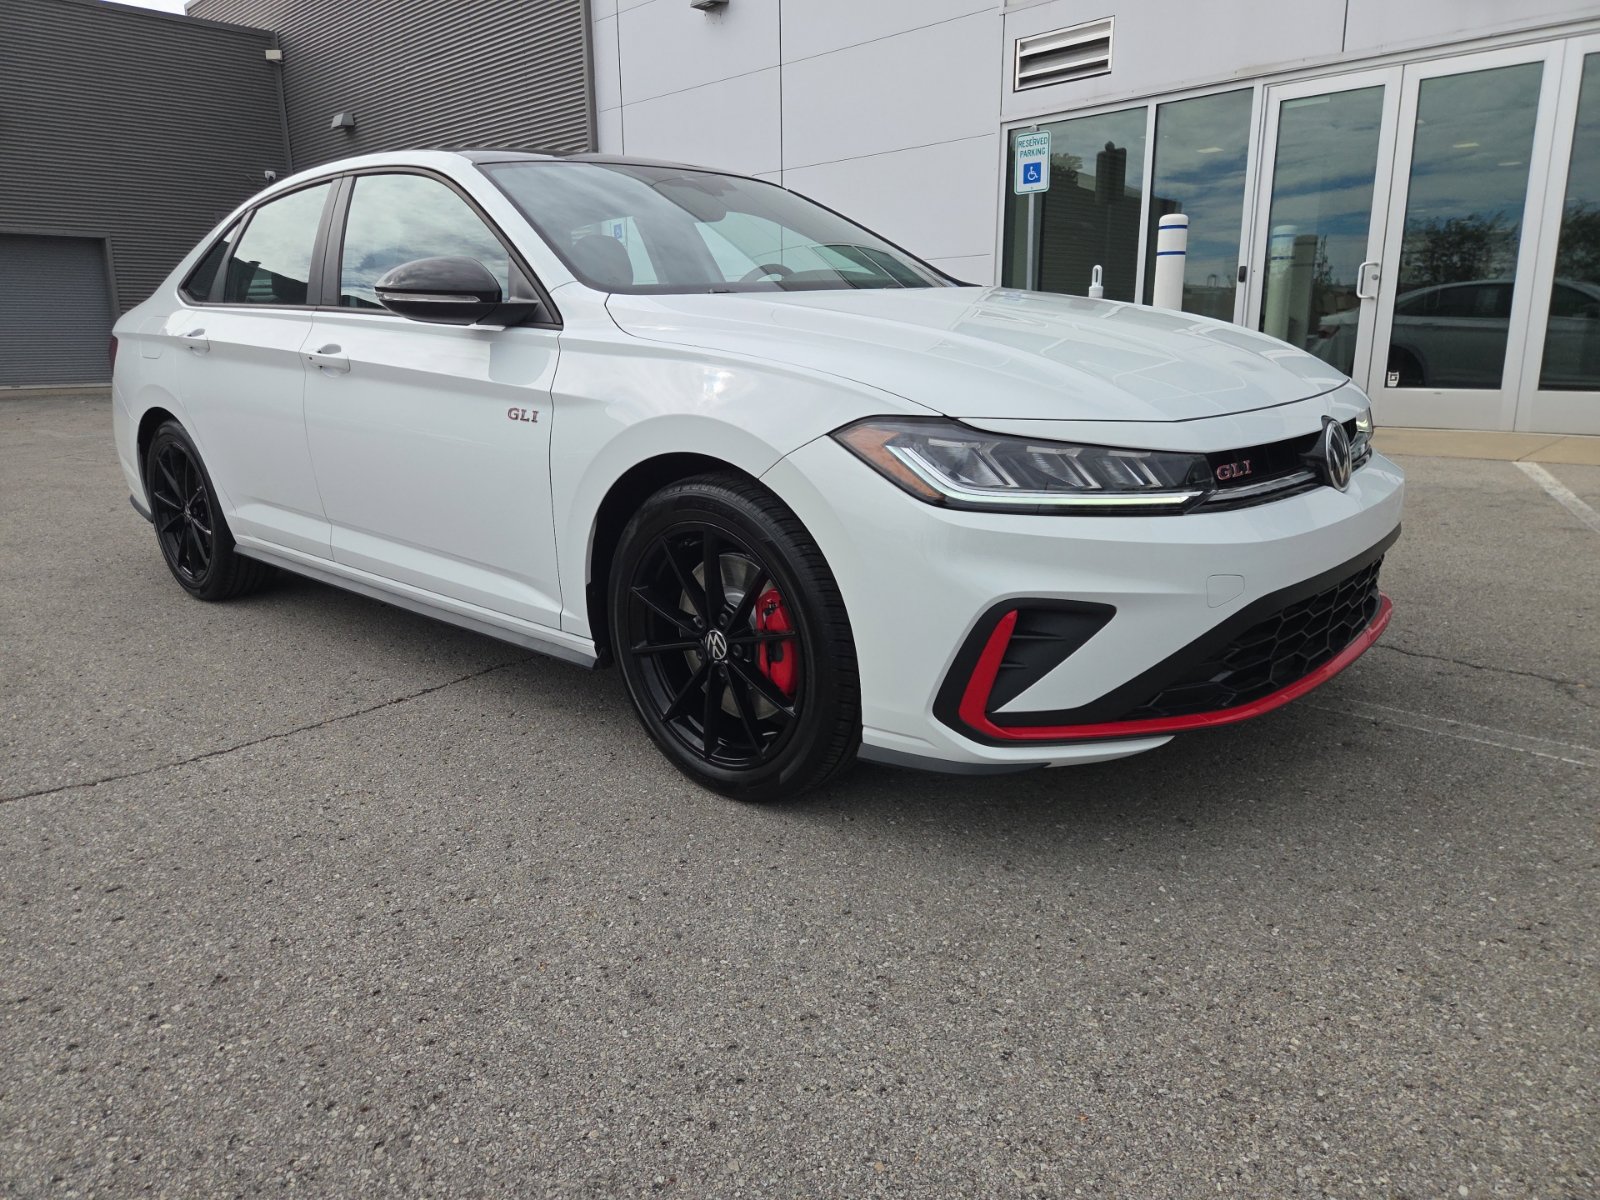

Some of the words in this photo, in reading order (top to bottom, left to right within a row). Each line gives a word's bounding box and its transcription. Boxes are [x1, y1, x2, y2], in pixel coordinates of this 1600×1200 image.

[1018, 137, 1047, 148] RESERVED
[1020, 148, 1046, 158] PARKING
[508, 407, 539, 423] GLI
[1216, 460, 1252, 480] GLI
